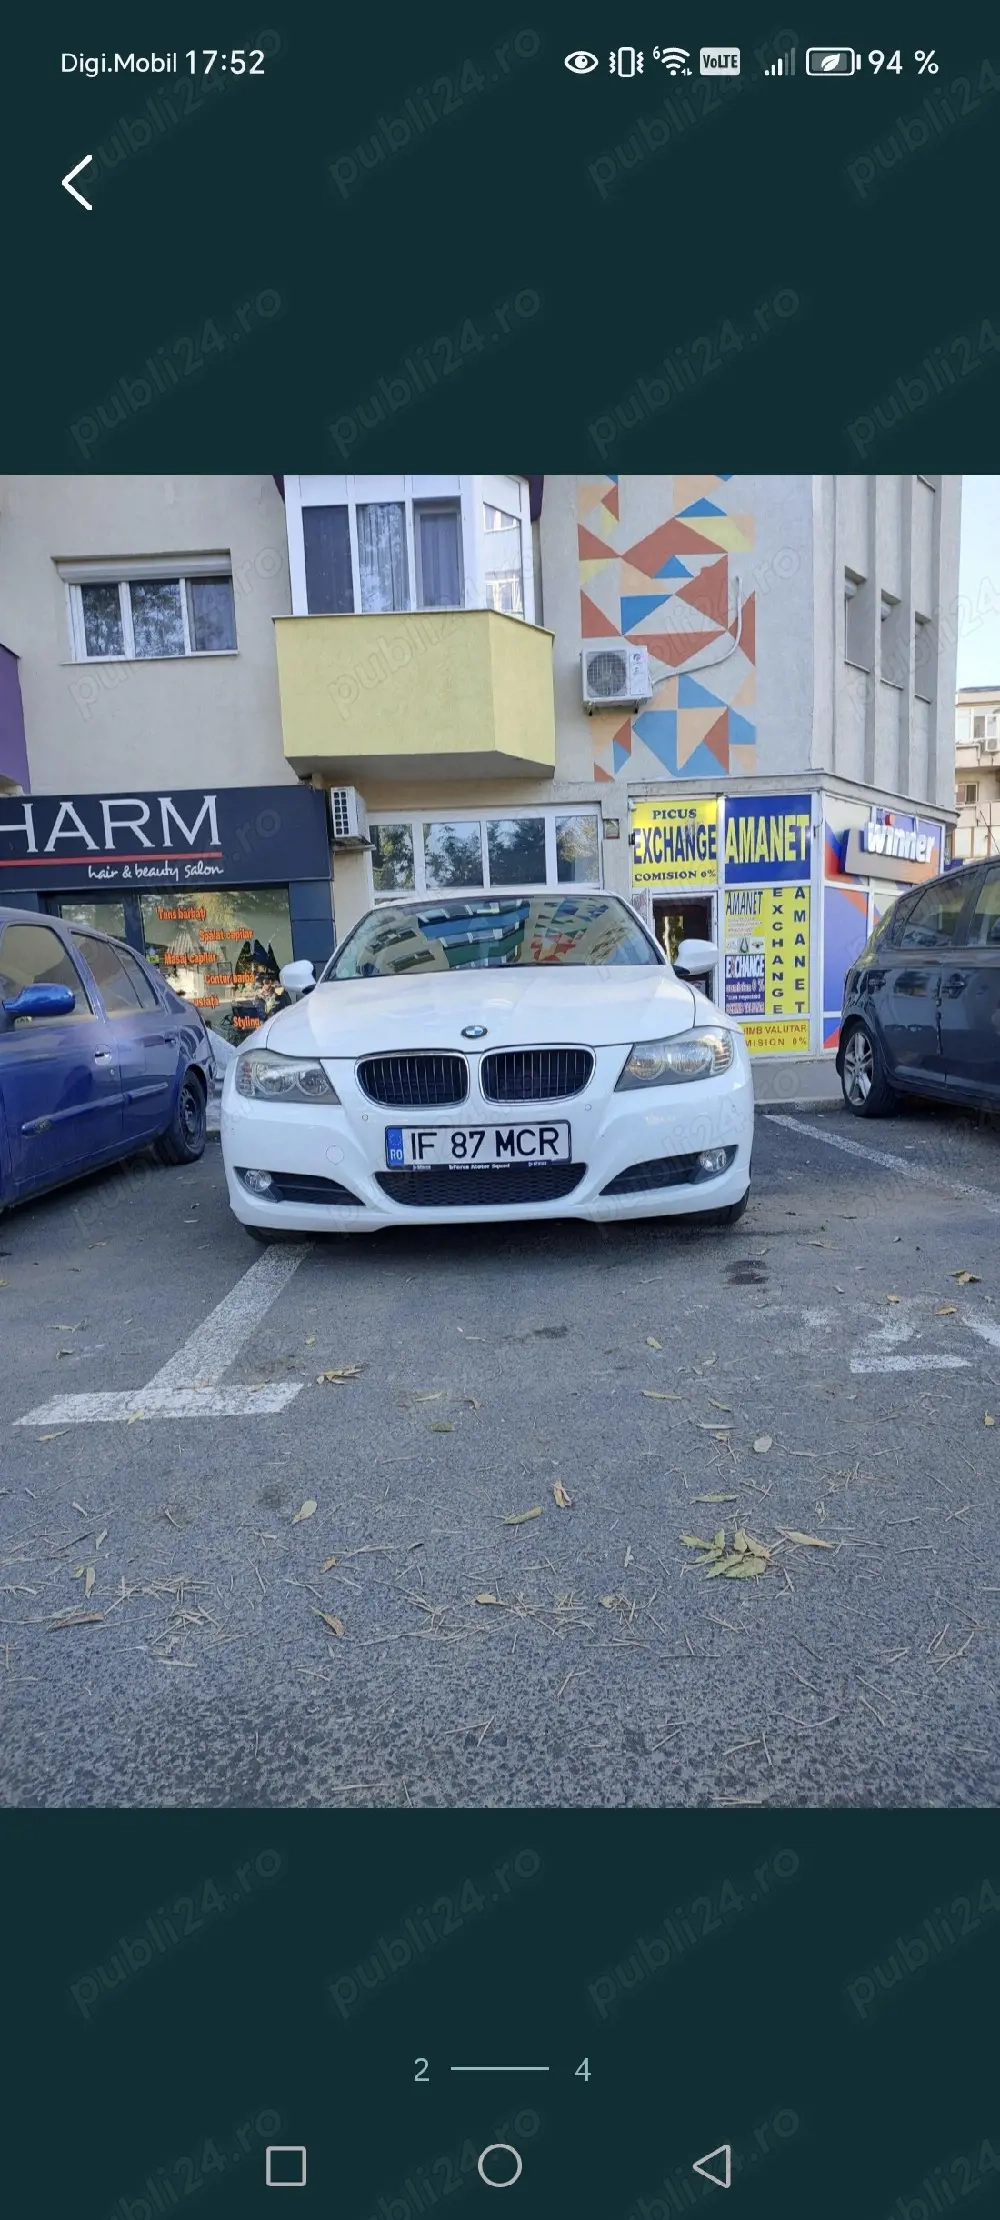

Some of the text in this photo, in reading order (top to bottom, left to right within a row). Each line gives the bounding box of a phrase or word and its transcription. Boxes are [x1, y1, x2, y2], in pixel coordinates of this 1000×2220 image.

[652, 808, 697, 819] PICUS
[633, 824, 716, 865] EXCHANGE
[725, 814, 810, 864] AMANET
[864, 814, 936, 864] winner
[87, 859, 224, 882] hair & beauty salon
[634, 871, 697, 882] COMISION
[726, 891, 763, 915] AMANET
[772, 887, 784, 1014] EXCHANGE
[794, 887, 806, 1014] AMANET
[726, 955, 765, 977] EXCHANGE
[765, 1024, 807, 1034] VALUTAR
[390, 1149, 403, 1161] RO
[411, 1127, 559, 1160] IF 87 MCR
